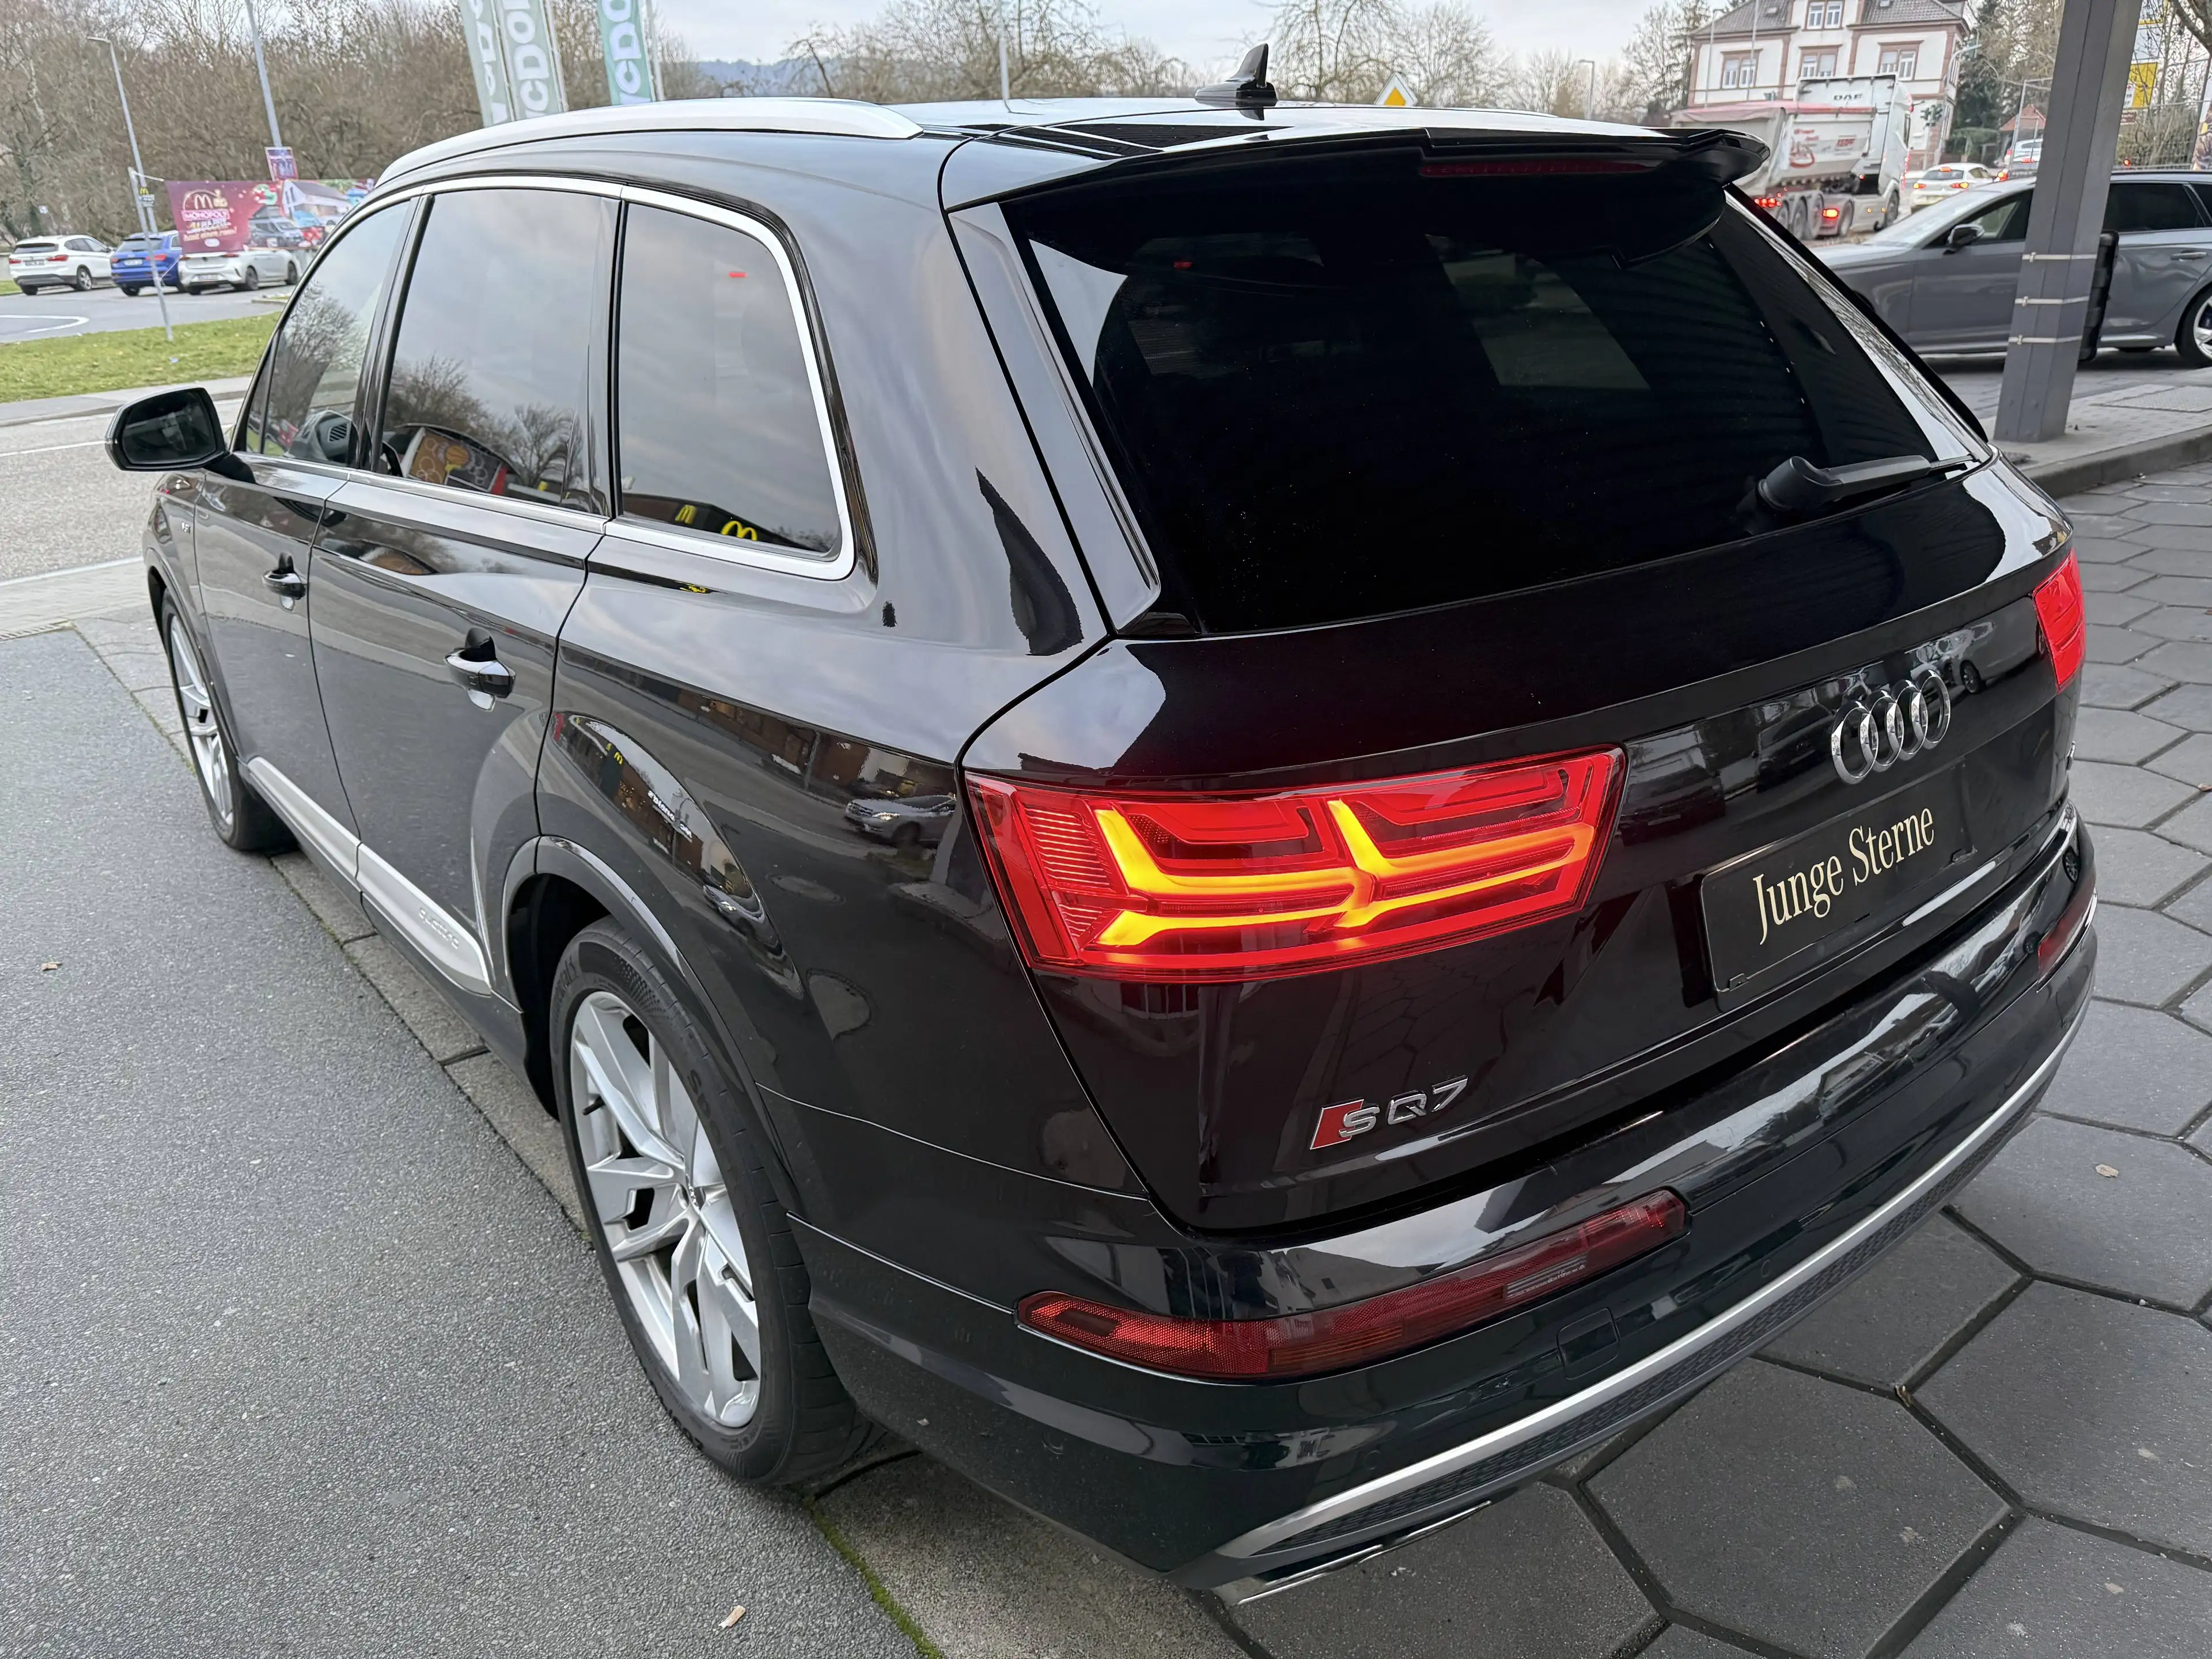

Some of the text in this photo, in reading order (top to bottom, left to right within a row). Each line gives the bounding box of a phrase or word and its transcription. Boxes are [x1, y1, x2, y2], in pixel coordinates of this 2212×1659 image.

[1753, 807, 1934, 945] Junge Sterne
[1338, 1074, 1468, 1138] SQ7
